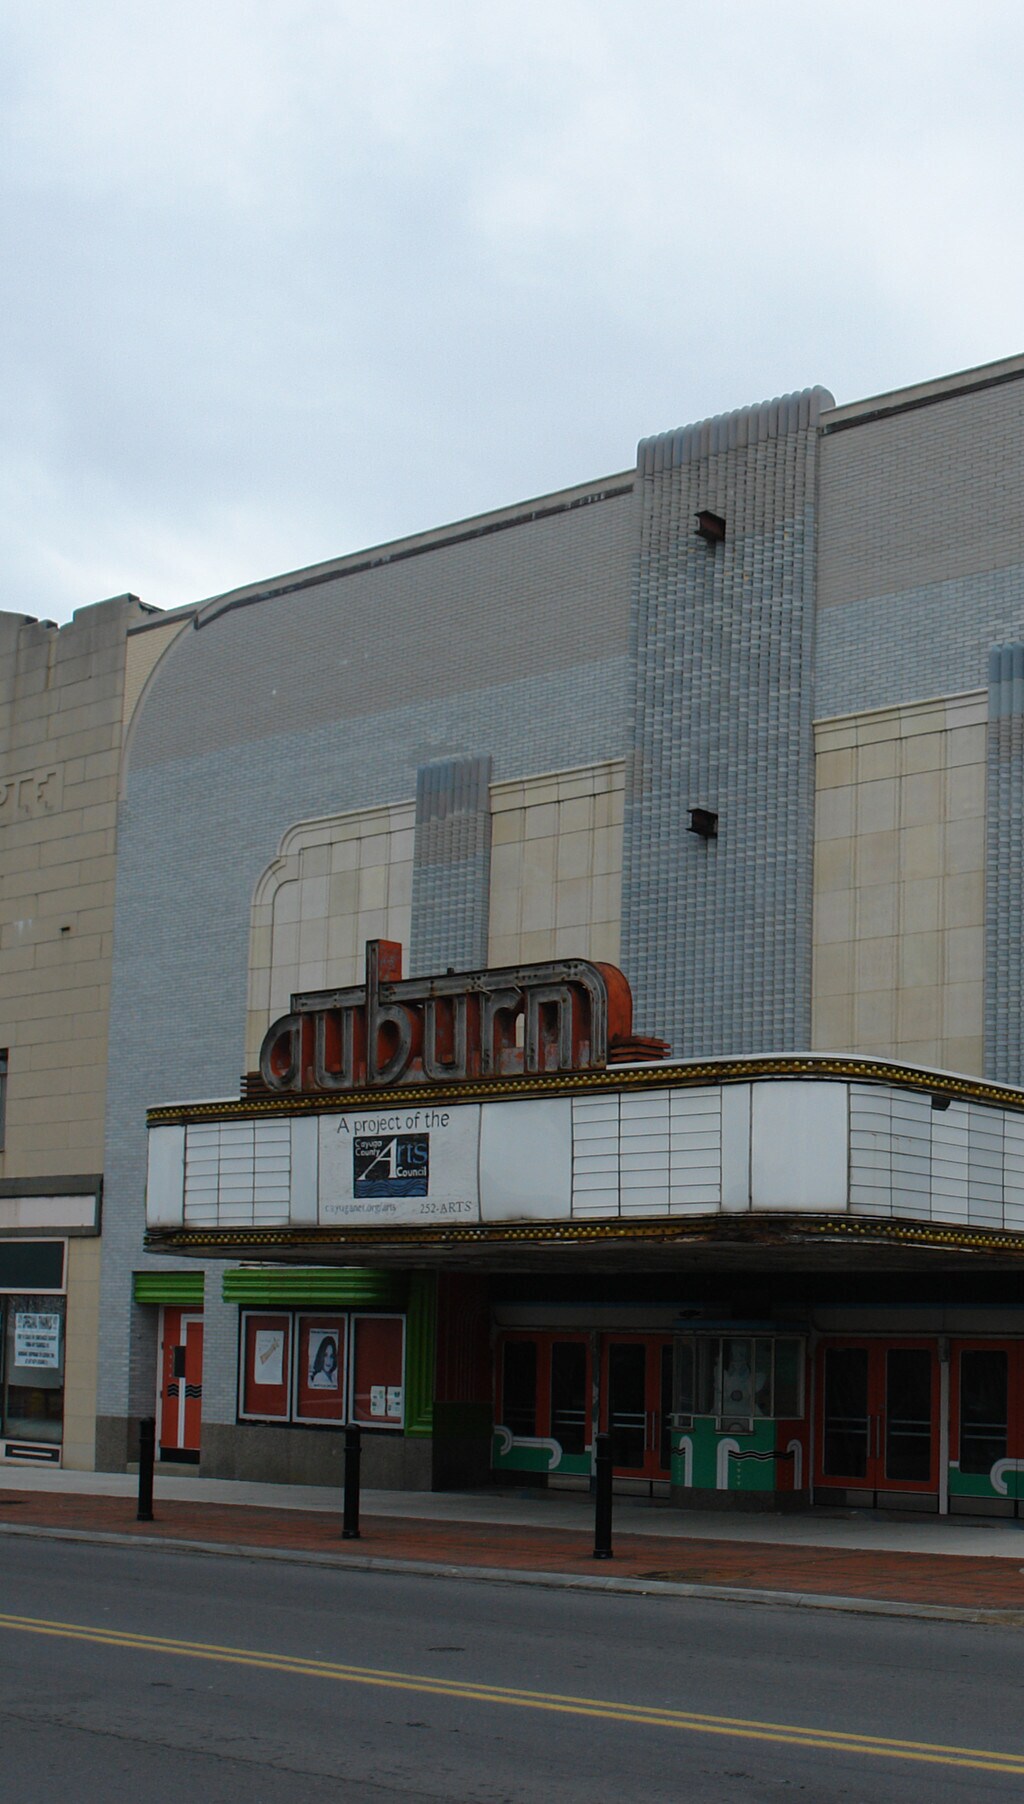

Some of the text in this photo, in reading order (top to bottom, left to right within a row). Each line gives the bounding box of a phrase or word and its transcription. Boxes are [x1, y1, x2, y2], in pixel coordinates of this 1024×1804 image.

[260, 939, 610, 1093] auburn
[337, 1110, 450, 1135] A project of the
[355, 1139, 383, 1149] Cayuga
[356, 1138, 428, 1180] Arts
[396, 1166, 427, 1177] Council
[420, 1200, 472, 1214] 252-ARTS
